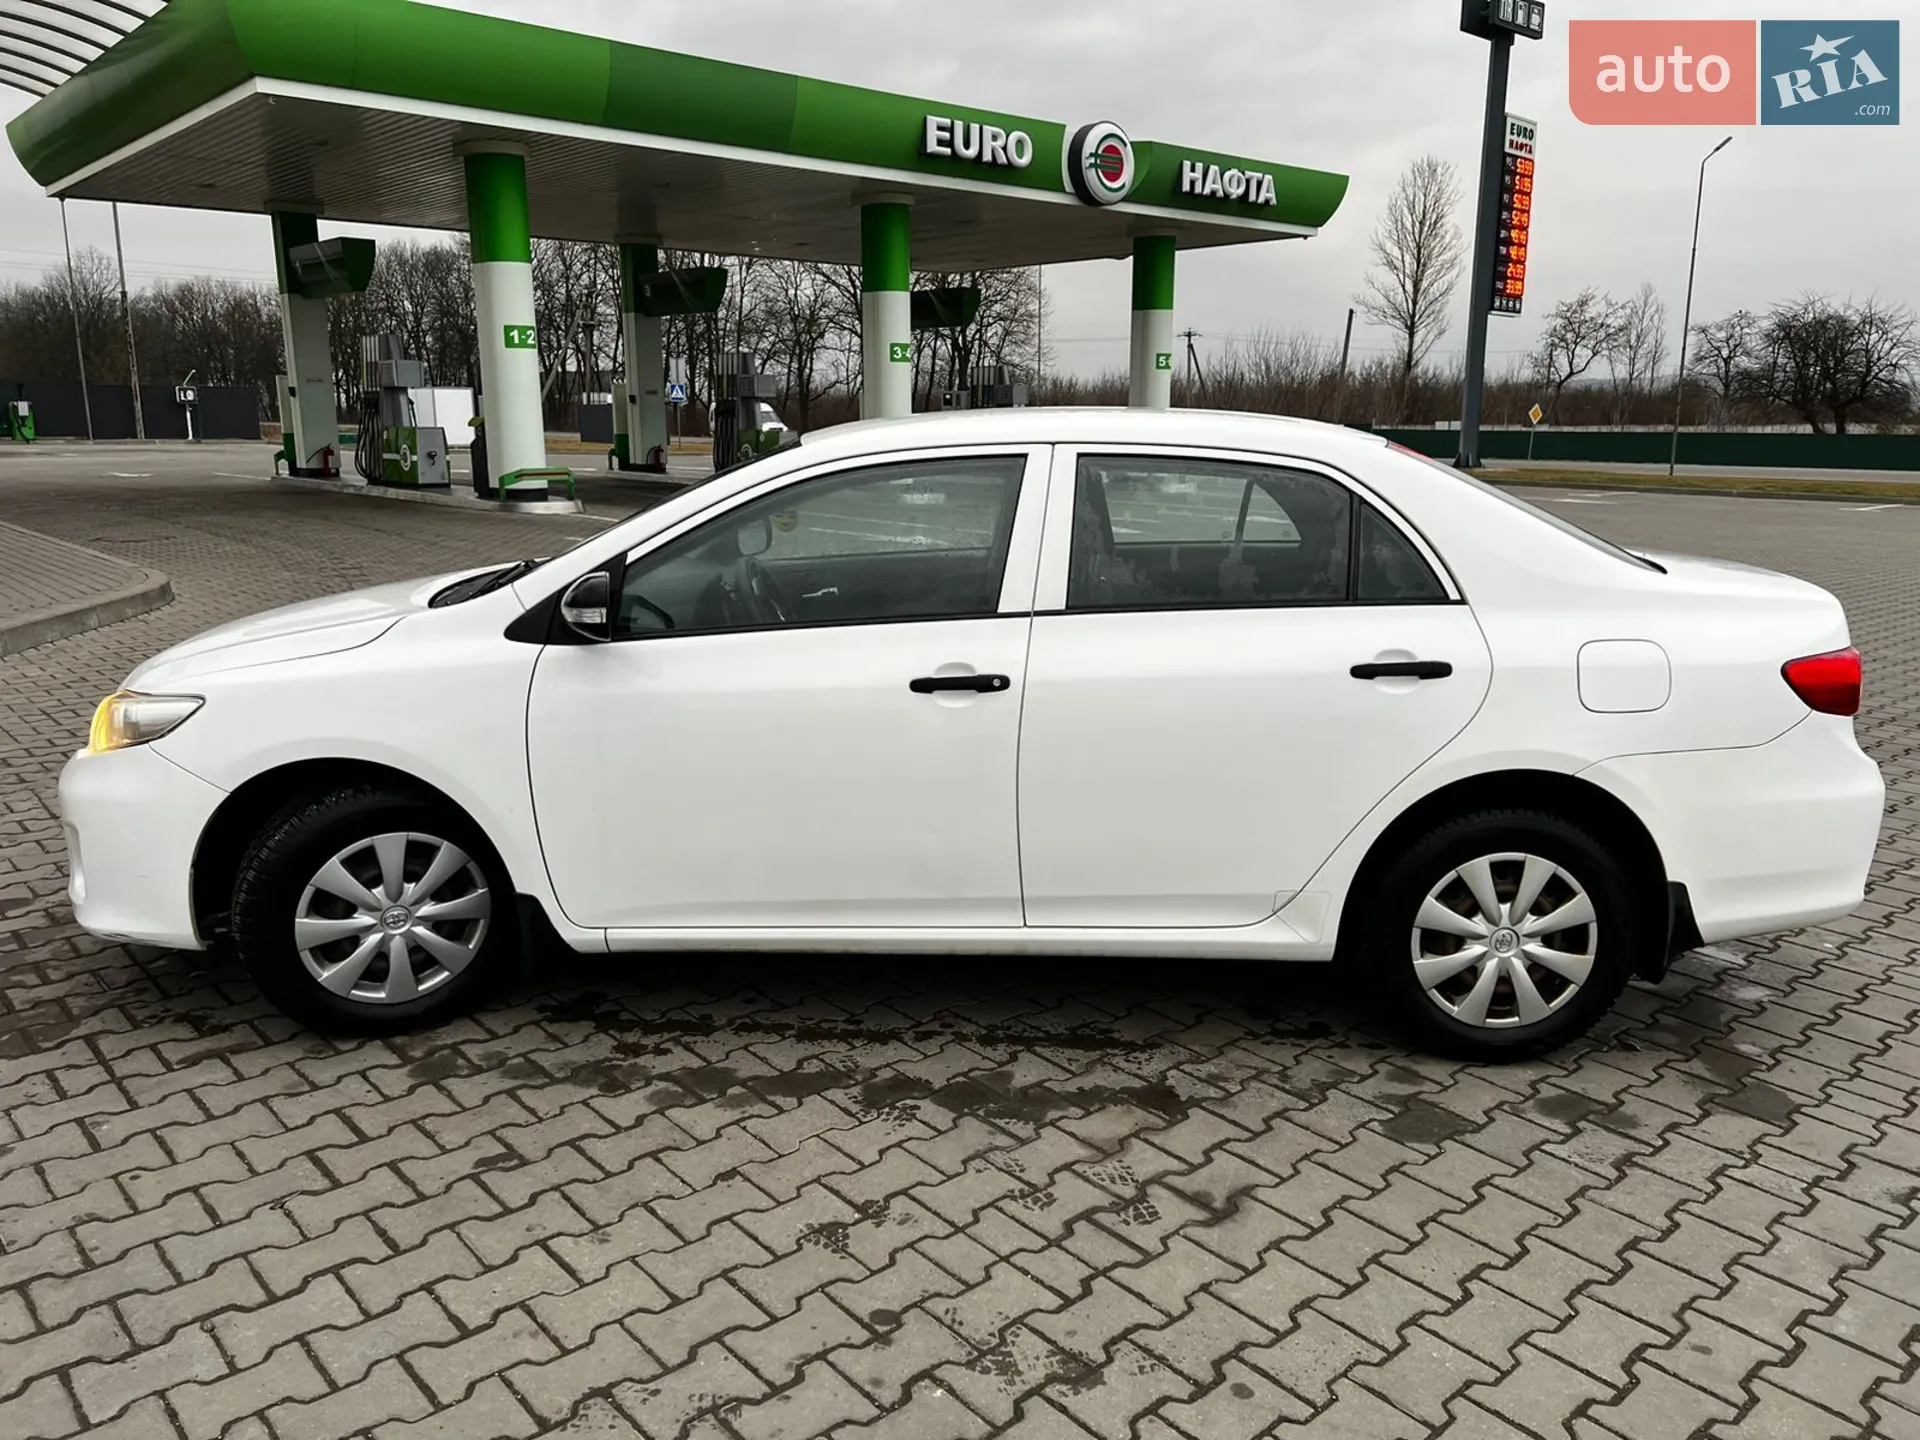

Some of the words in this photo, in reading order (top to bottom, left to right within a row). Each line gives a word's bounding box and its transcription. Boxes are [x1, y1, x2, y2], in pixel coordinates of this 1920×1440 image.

[1510, 122, 1534, 141] EURO
[925, 114, 1033, 169] EURO
[1508, 138, 1533, 155] НАФТА
[1181, 159, 1278, 206] НАФТА
[509, 329, 536, 344] 1-2
